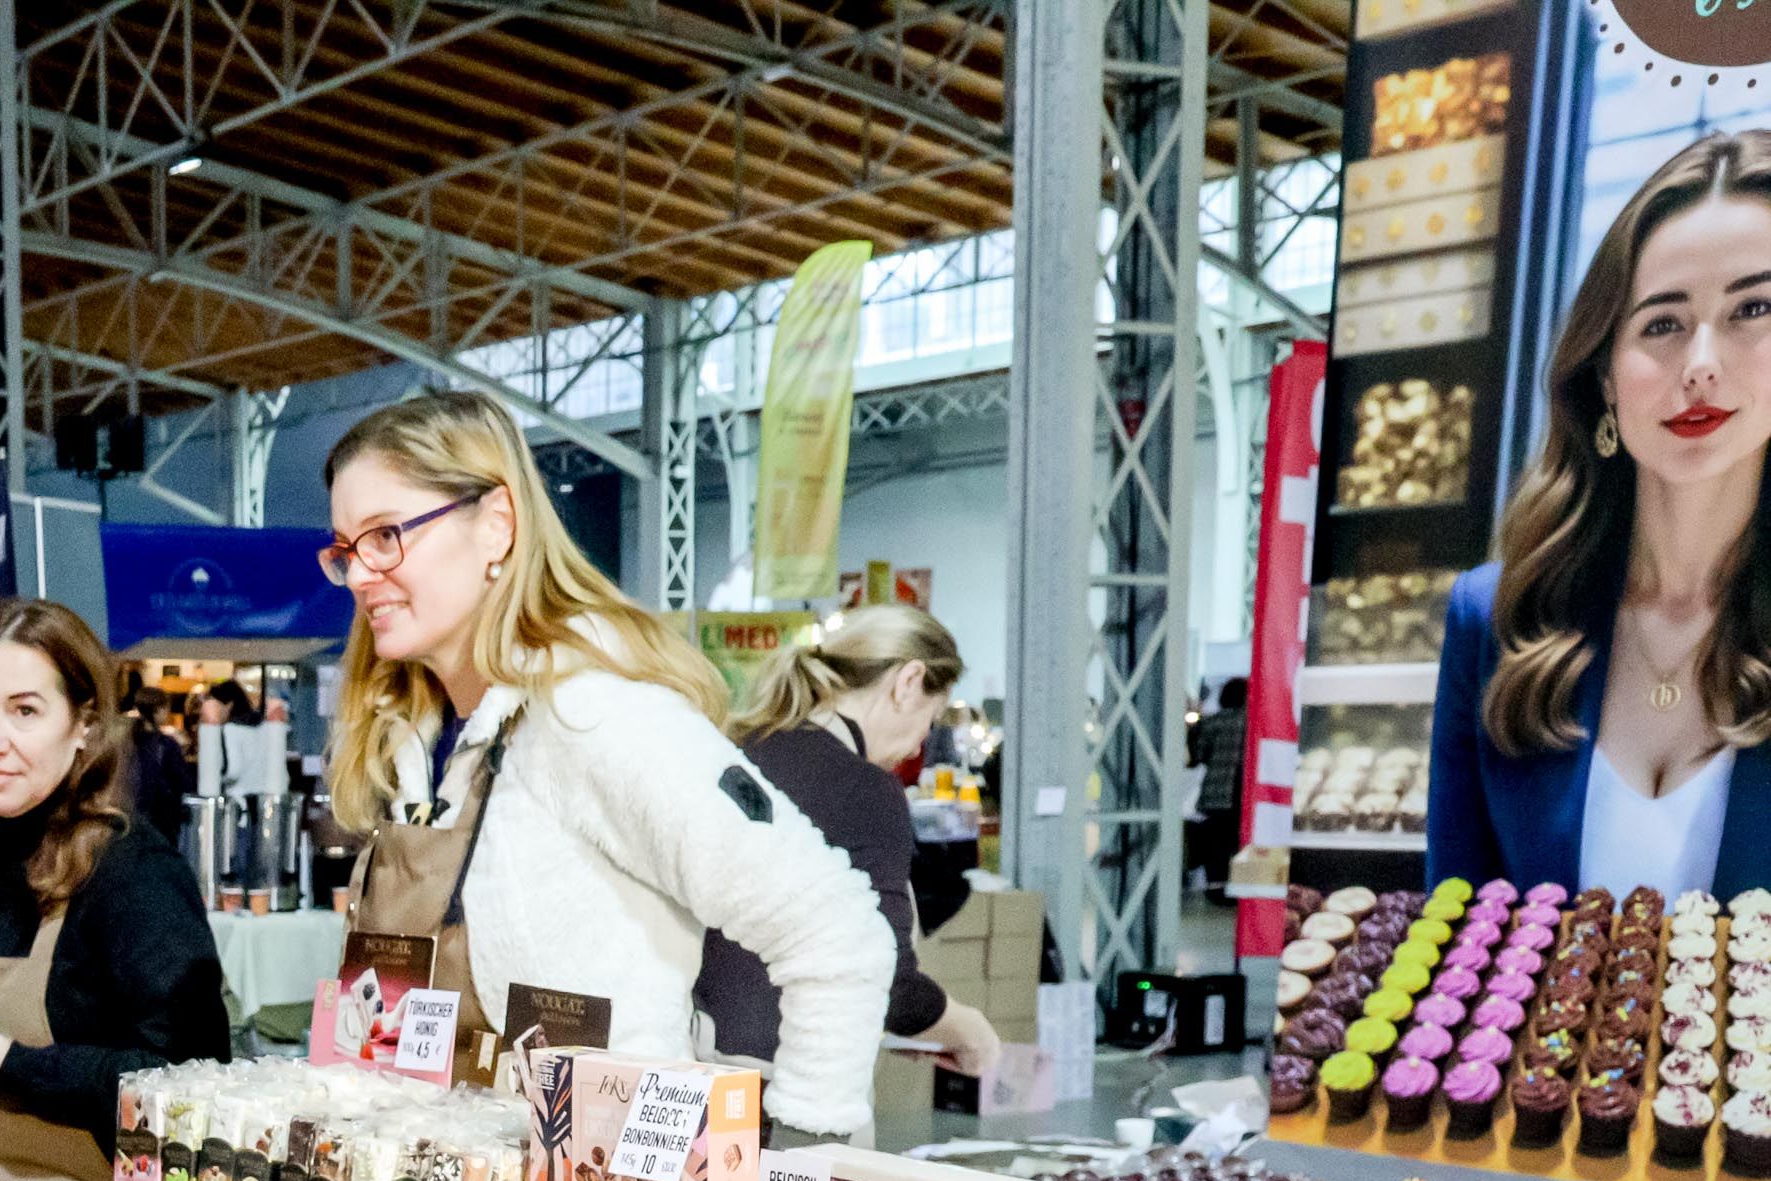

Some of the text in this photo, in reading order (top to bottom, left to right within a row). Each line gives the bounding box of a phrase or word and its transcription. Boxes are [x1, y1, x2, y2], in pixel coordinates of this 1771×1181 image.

[415, 1020, 438, 1036] HONIG
[640, 1072, 706, 1106] Premium
[622, 1127, 691, 1152] BONBONNIERE
[641, 1154, 657, 1174] 10
